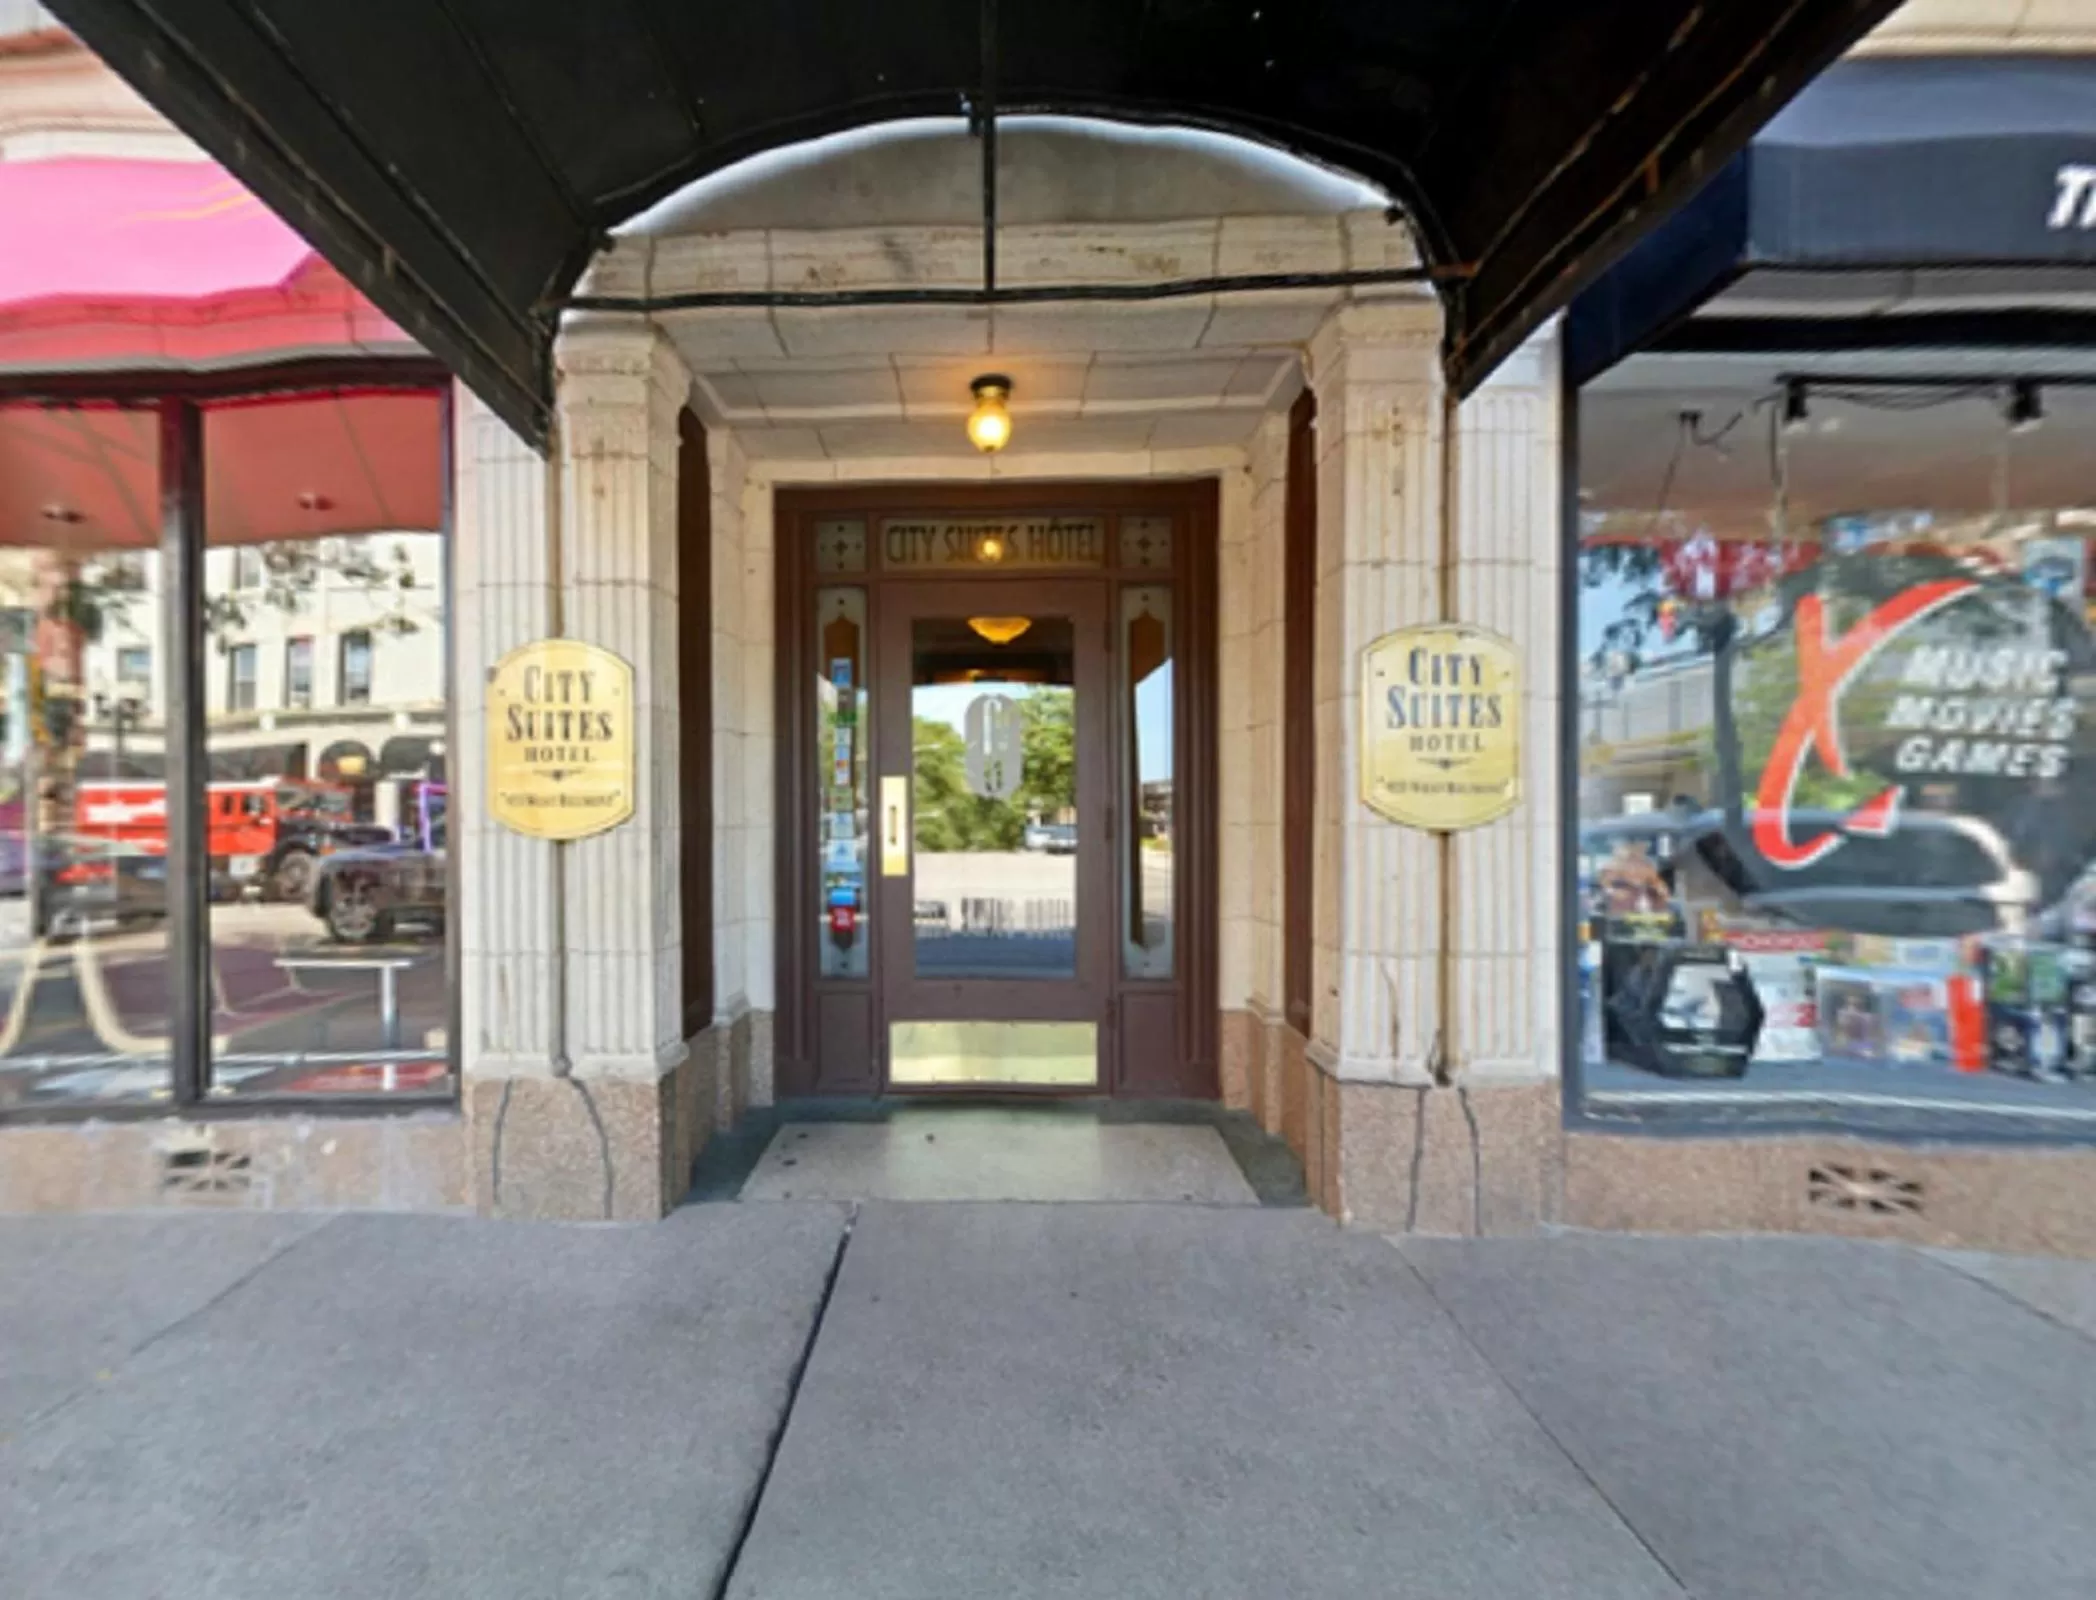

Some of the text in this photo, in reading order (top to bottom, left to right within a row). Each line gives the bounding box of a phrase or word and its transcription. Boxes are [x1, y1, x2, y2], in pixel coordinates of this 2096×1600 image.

[887, 525, 936, 563] CITY
[524, 665, 595, 704] CITY
[1409, 647, 1484, 686] CITY
[1900, 644, 2069, 693] MUSIC
[507, 704, 613, 741] SUITES
[1387, 685, 1502, 729] SUITES
[524, 746, 598, 762] HOTEL
[1410, 733, 1484, 752] HOTEL
[1896, 735, 2070, 778] GAMES
